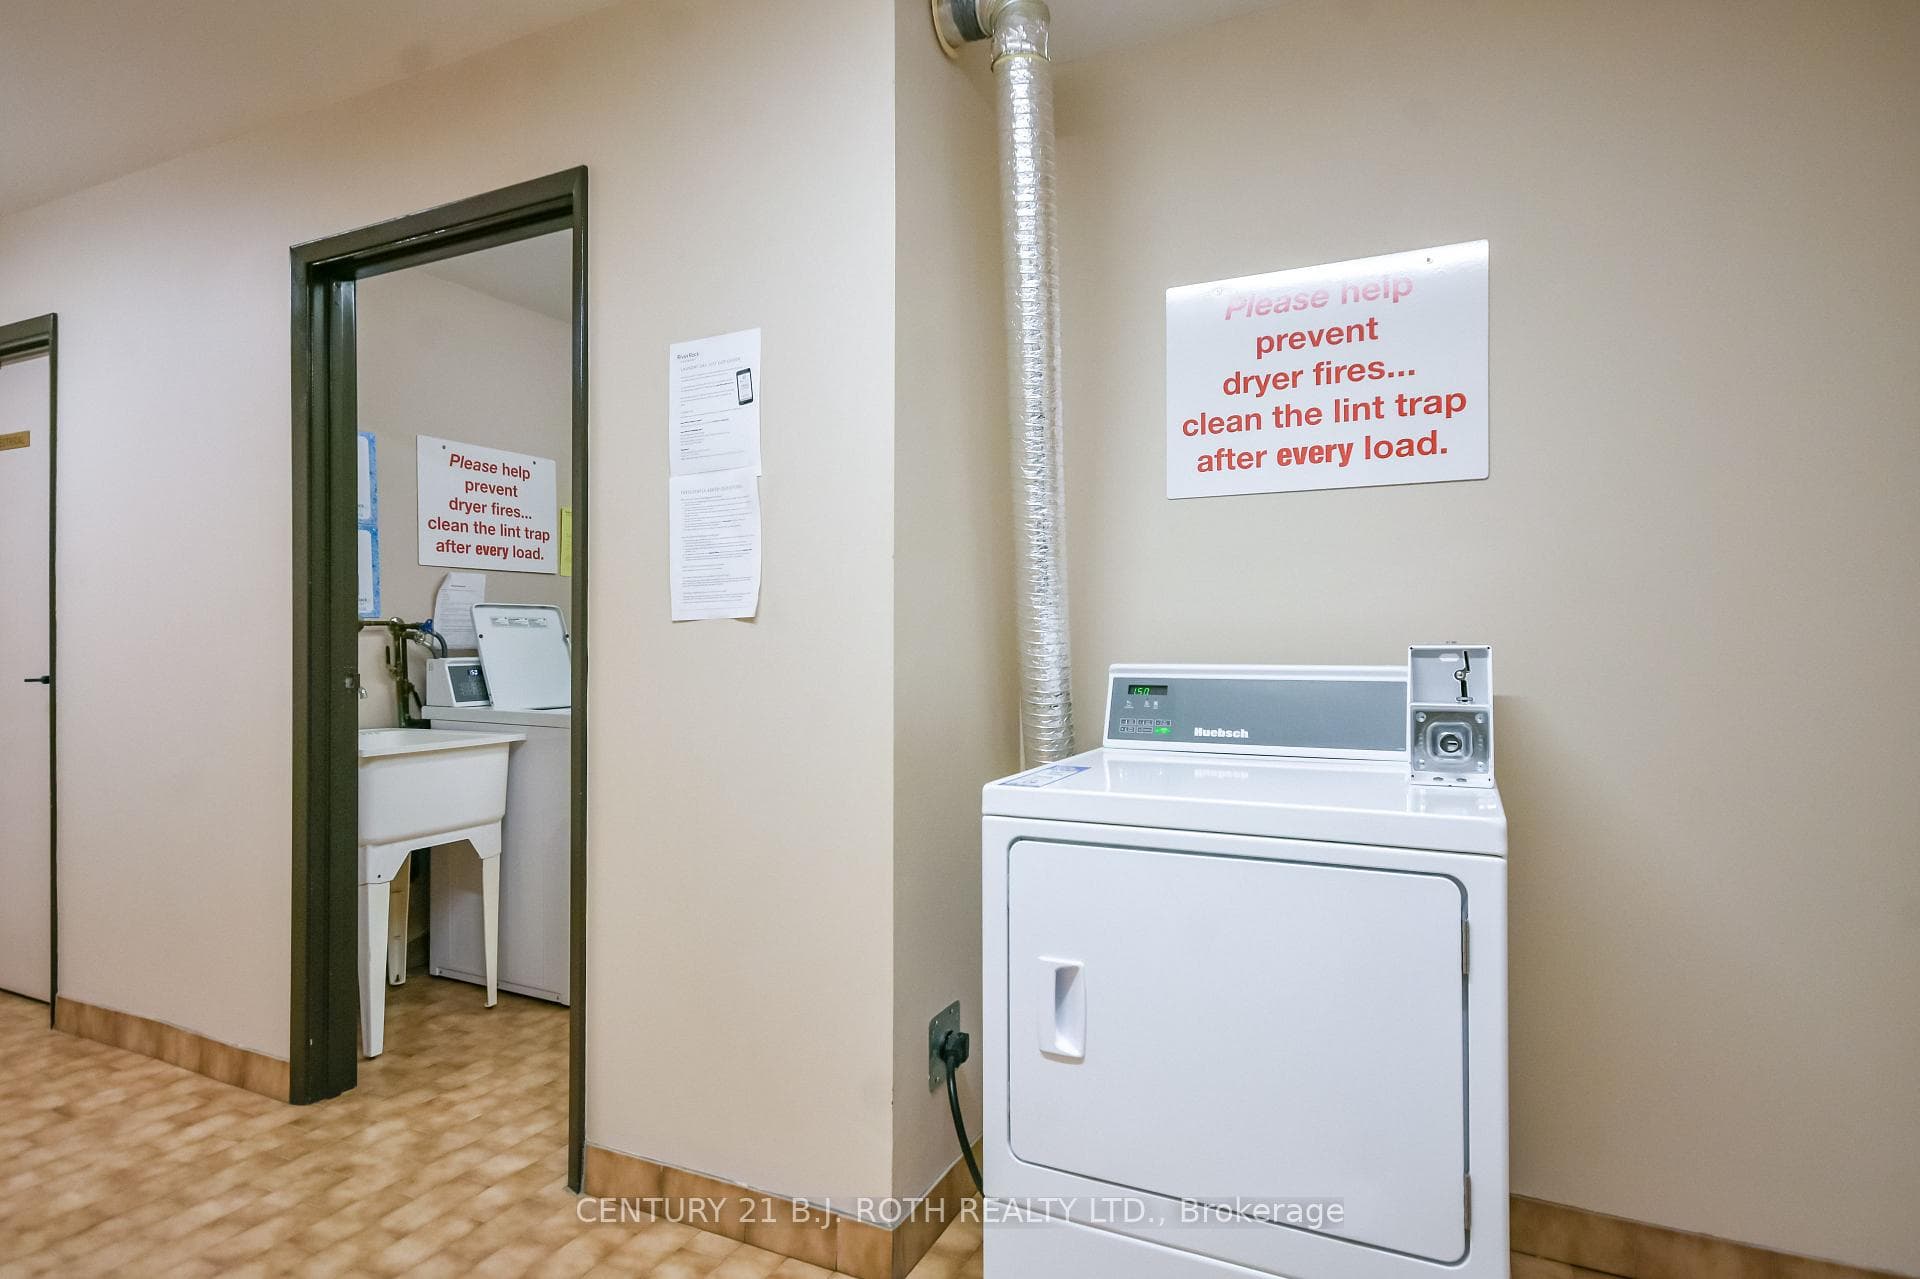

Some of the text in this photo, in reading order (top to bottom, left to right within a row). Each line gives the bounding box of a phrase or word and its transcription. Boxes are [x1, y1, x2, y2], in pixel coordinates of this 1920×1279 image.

[1225, 277, 1414, 321] Please help
[1256, 317, 1379, 360] prevent
[1223, 360, 1417, 398] dryer fires...
[1182, 391, 1468, 437] clean the lint trap
[1196, 429, 1448, 473] after every load.
[449, 453, 531, 482] Please help
[464, 480, 518, 498] prevent
[448, 497, 532, 520] dryer fires...
[427, 516, 550, 544] clean the lint trap
[435, 539, 545, 560] after every load.
[1193, 727, 1249, 739] Huebsch
